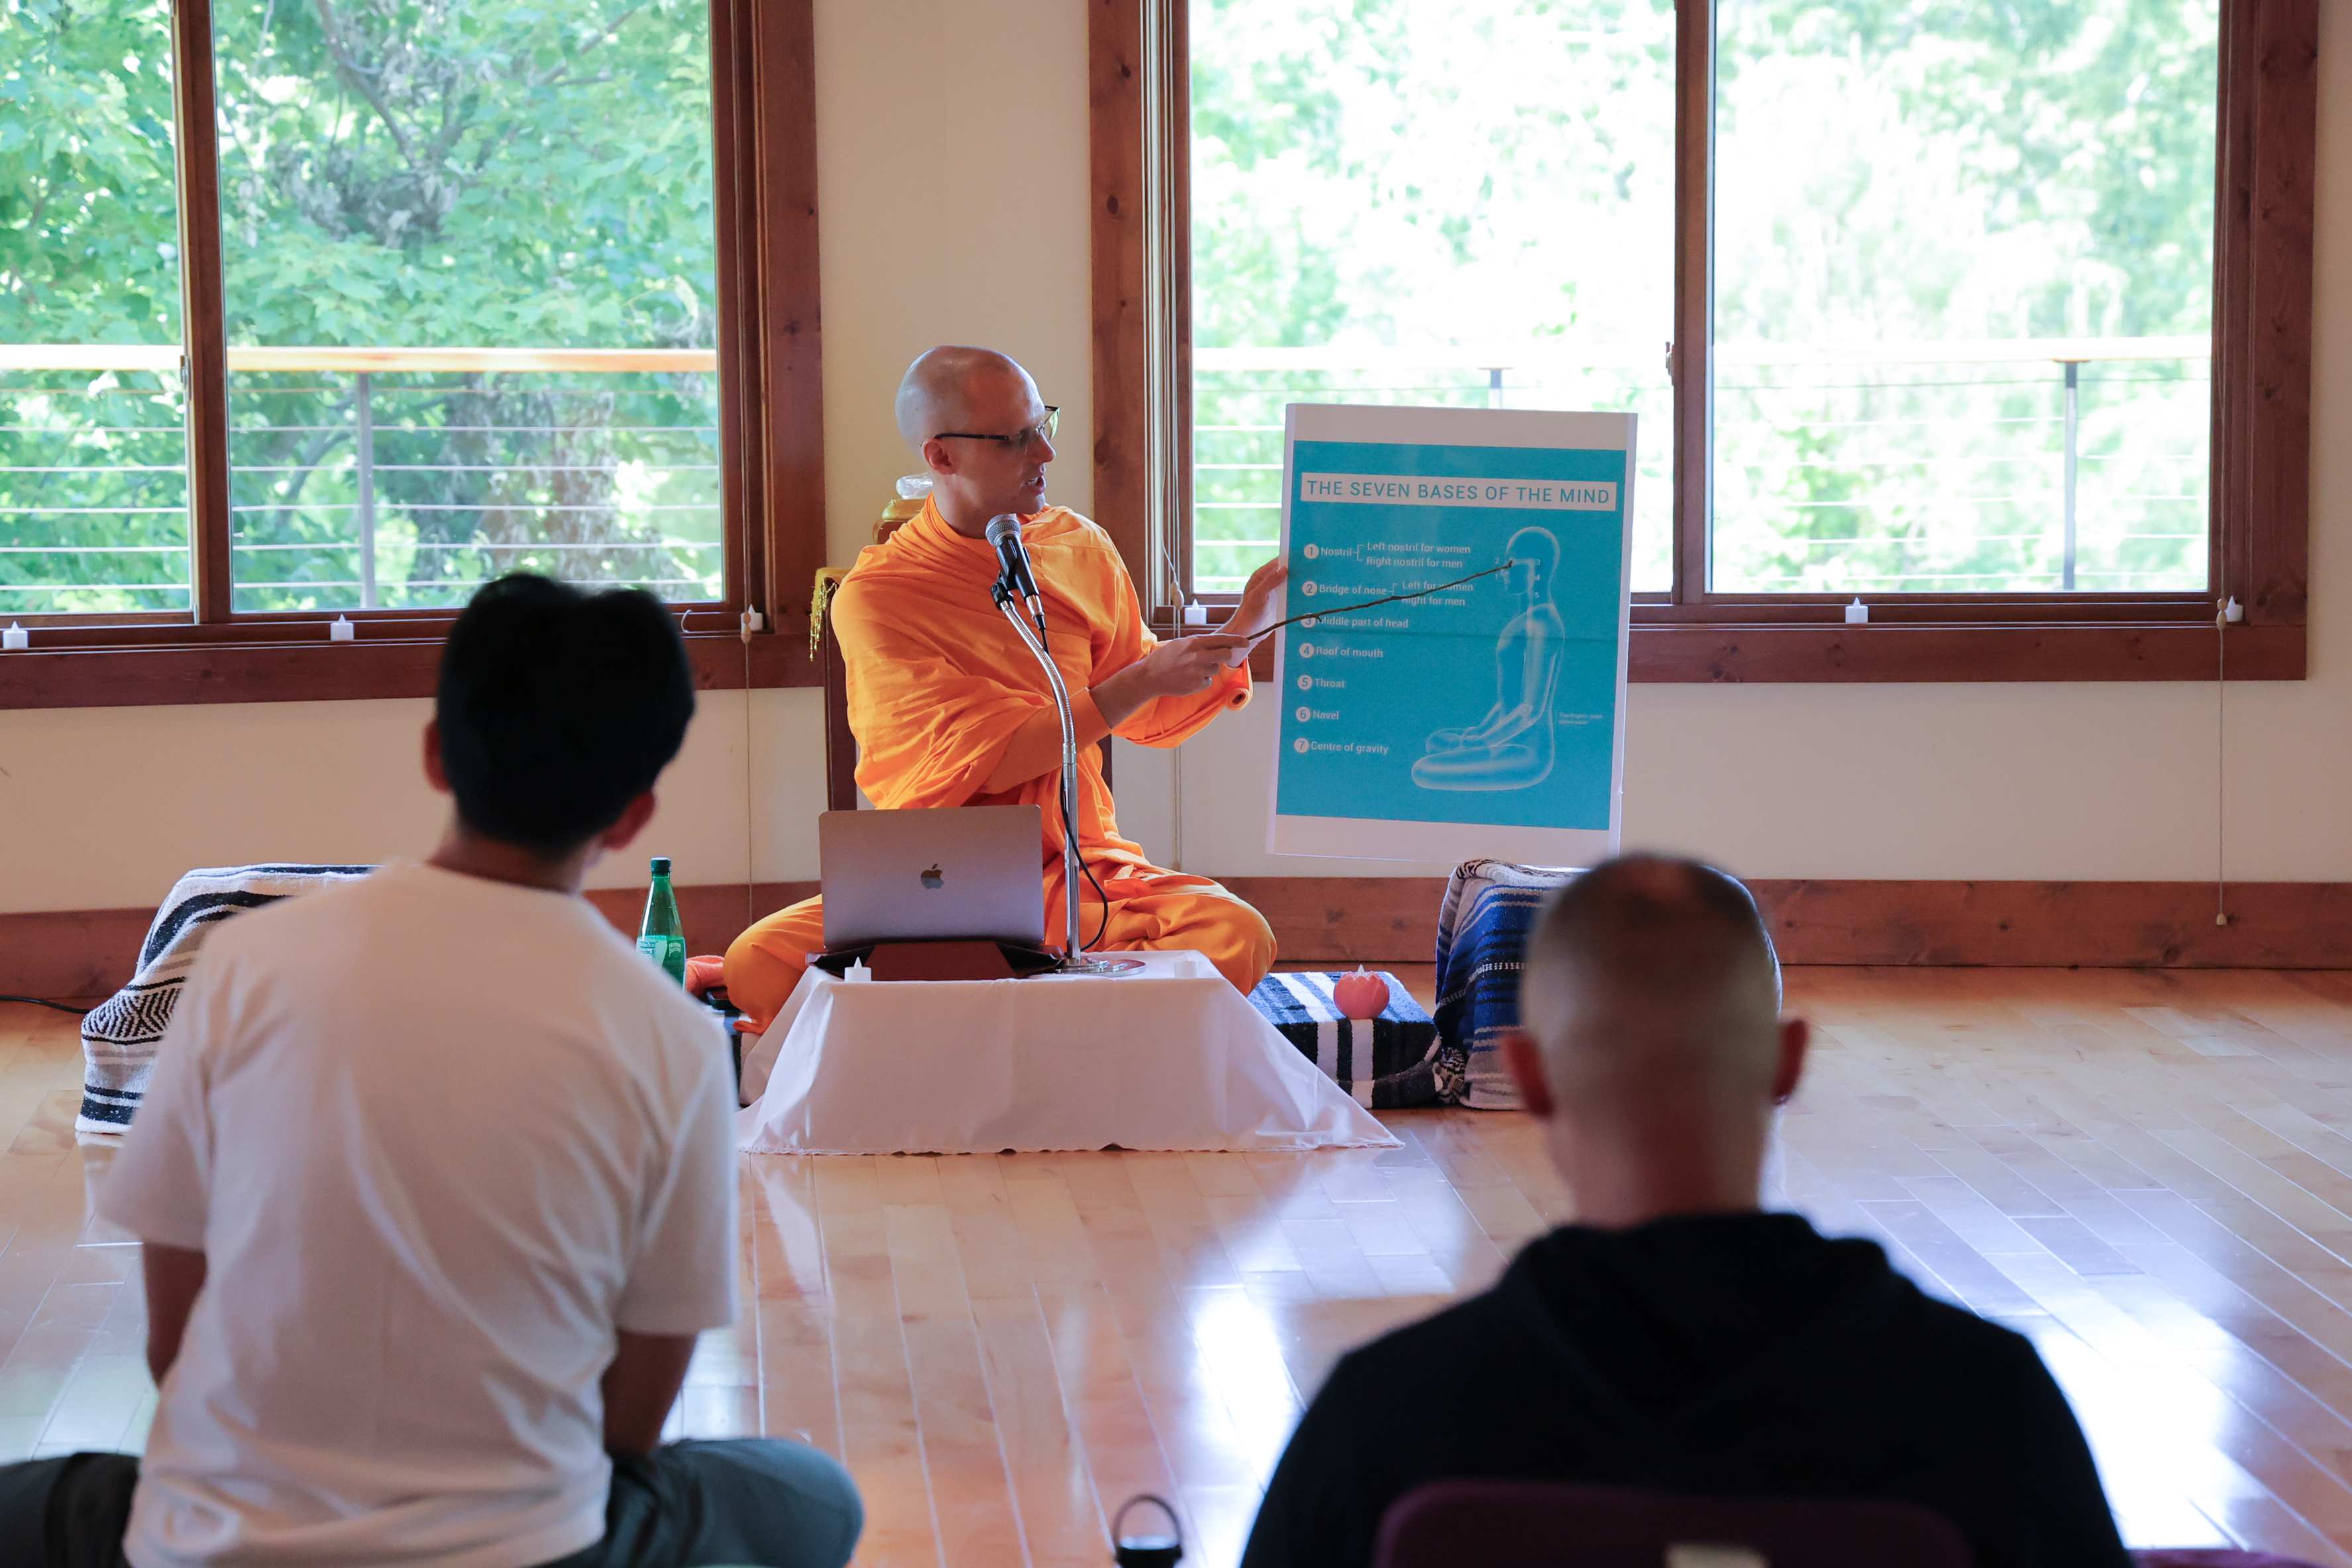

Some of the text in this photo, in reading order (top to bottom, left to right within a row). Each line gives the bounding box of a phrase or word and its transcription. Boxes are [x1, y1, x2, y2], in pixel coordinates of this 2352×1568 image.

[1308, 480, 1609, 503] THE SEVEN BASES OF THE MIND
[1321, 547, 1352, 556] Nostril
[1367, 542, 1385, 551] Left
[1388, 543, 1418, 551] nostril
[1367, 557, 1391, 567] Right
[1394, 558, 1424, 567] nostril
[1427, 559, 1439, 567] for
[1319, 585, 1349, 596] Bridge
[1352, 585, 1362, 594] of
[1424, 581, 1437, 590] for
[1352, 618, 1371, 627] part
[1373, 618, 1384, 626] of
[1386, 619, 1408, 628] head
[1316, 646, 1338, 655] Roof
[1341, 647, 1350, 656] of
[1353, 649, 1383, 657] mouth
[1315, 678, 1345, 688] Throat
[1313, 710, 1339, 719] Navel
[1311, 742, 1341, 751] Centre
[1344, 742, 1354, 752] of
[1356, 745, 1388, 755] gravity
